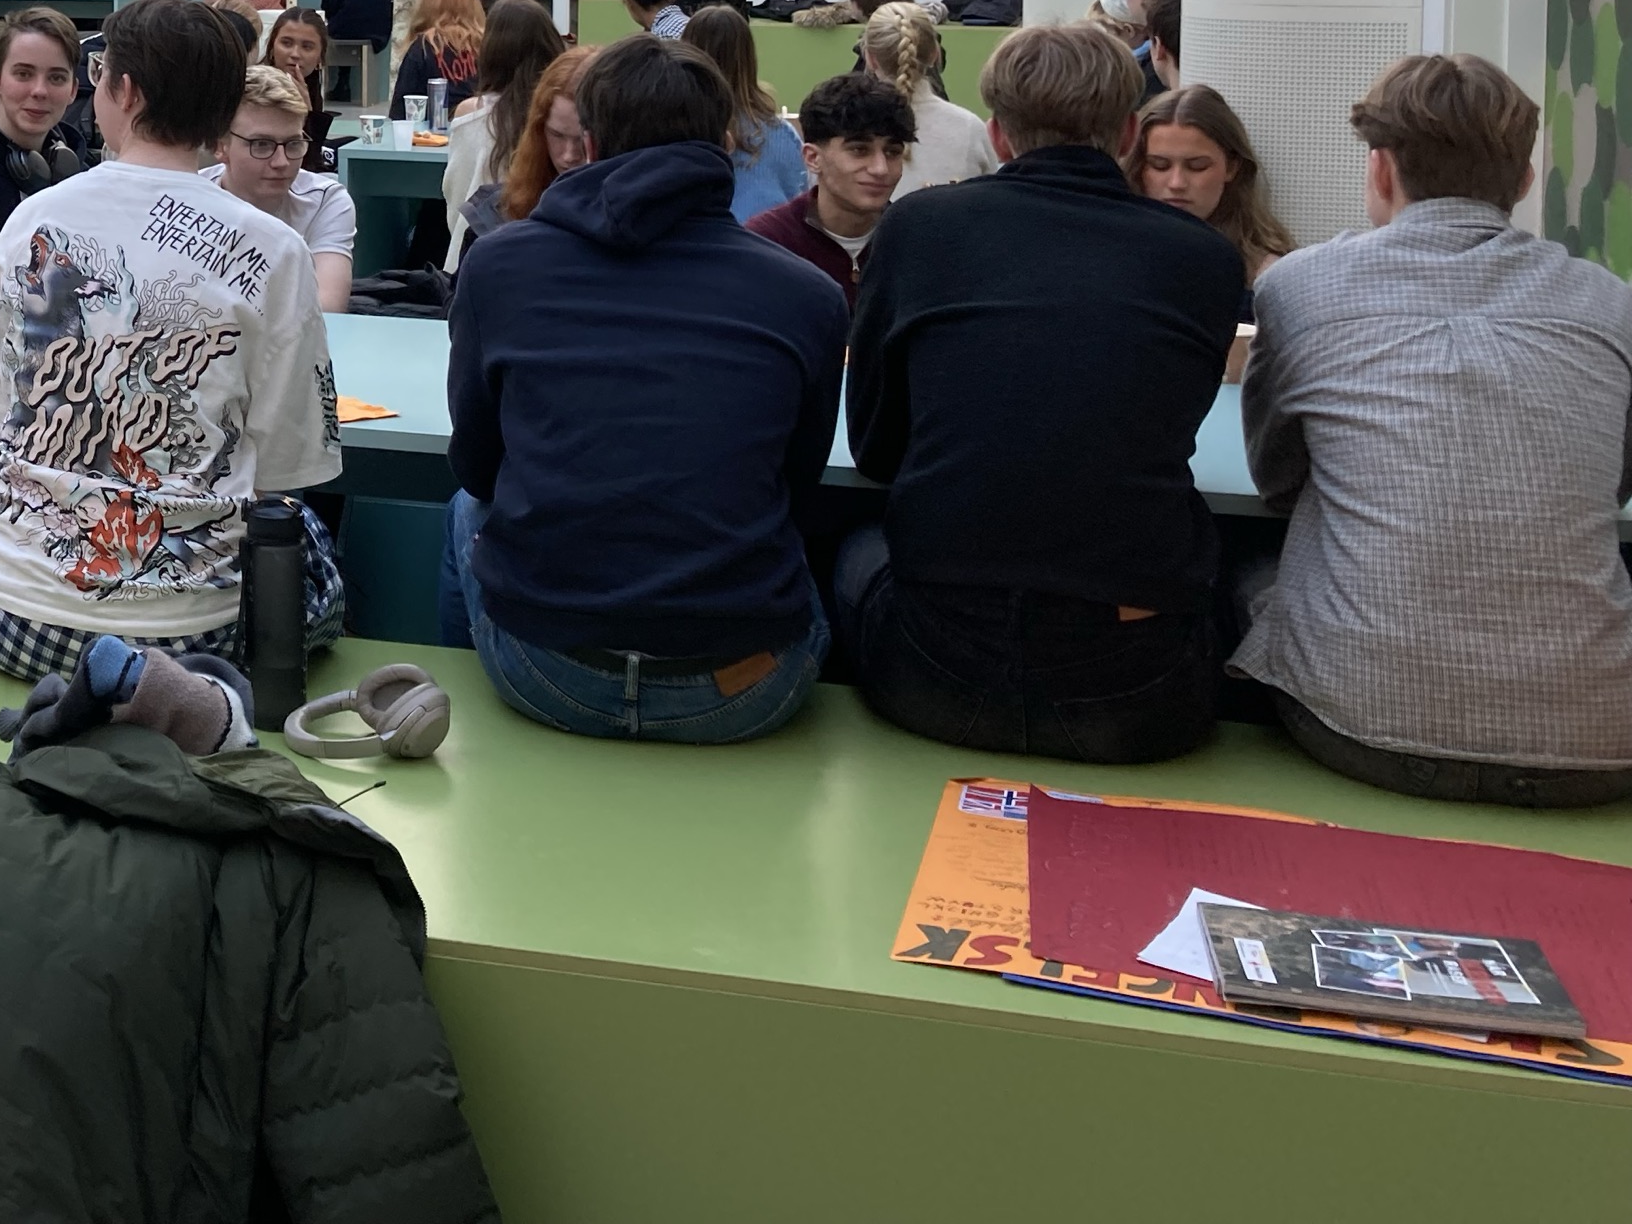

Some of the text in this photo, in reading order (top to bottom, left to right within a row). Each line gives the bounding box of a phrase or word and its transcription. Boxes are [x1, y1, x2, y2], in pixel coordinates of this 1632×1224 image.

[140, 217, 237, 278] ENTERTAIN
[149, 194, 246, 253] ENTERTAIN
[28, 324, 241, 408] OUT OF
